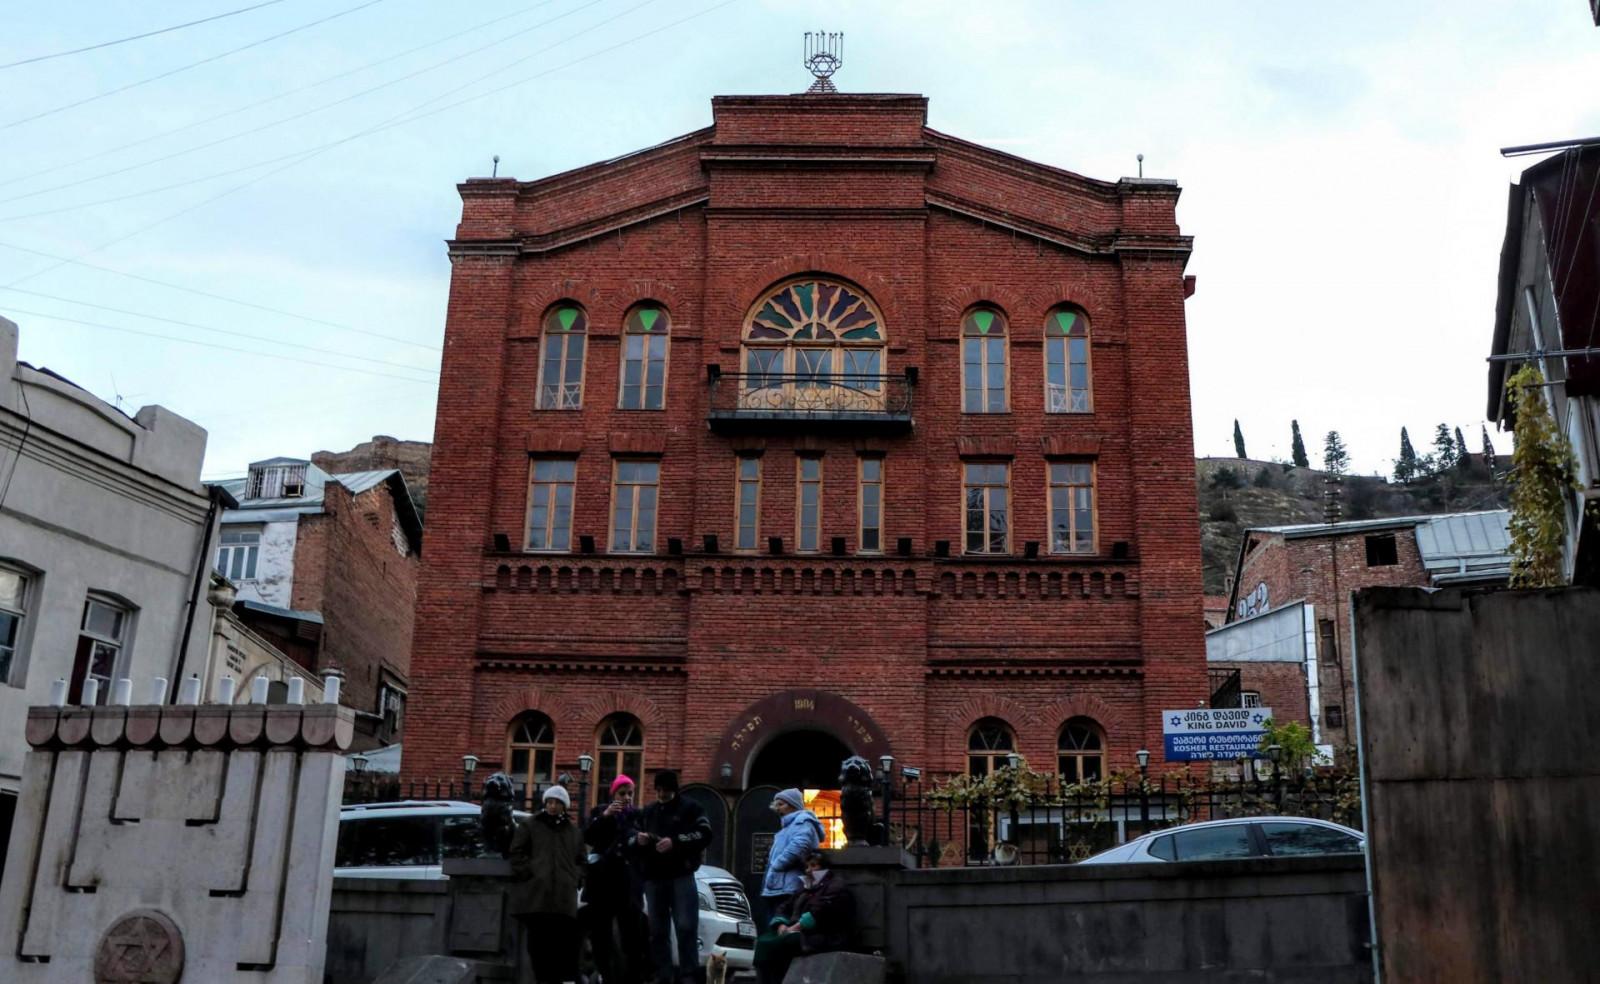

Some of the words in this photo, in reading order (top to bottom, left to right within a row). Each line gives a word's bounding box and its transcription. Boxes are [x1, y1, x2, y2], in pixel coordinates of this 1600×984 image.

[1184, 711, 1209, 721] კინგ
[1213, 711, 1249, 720] დავიდ
[1188, 721, 1212, 729] KING
[1215, 721, 1247, 729] DAVID
[1174, 744, 1207, 752] KOSHER
[1209, 743, 1258, 751] RESTAURAN
